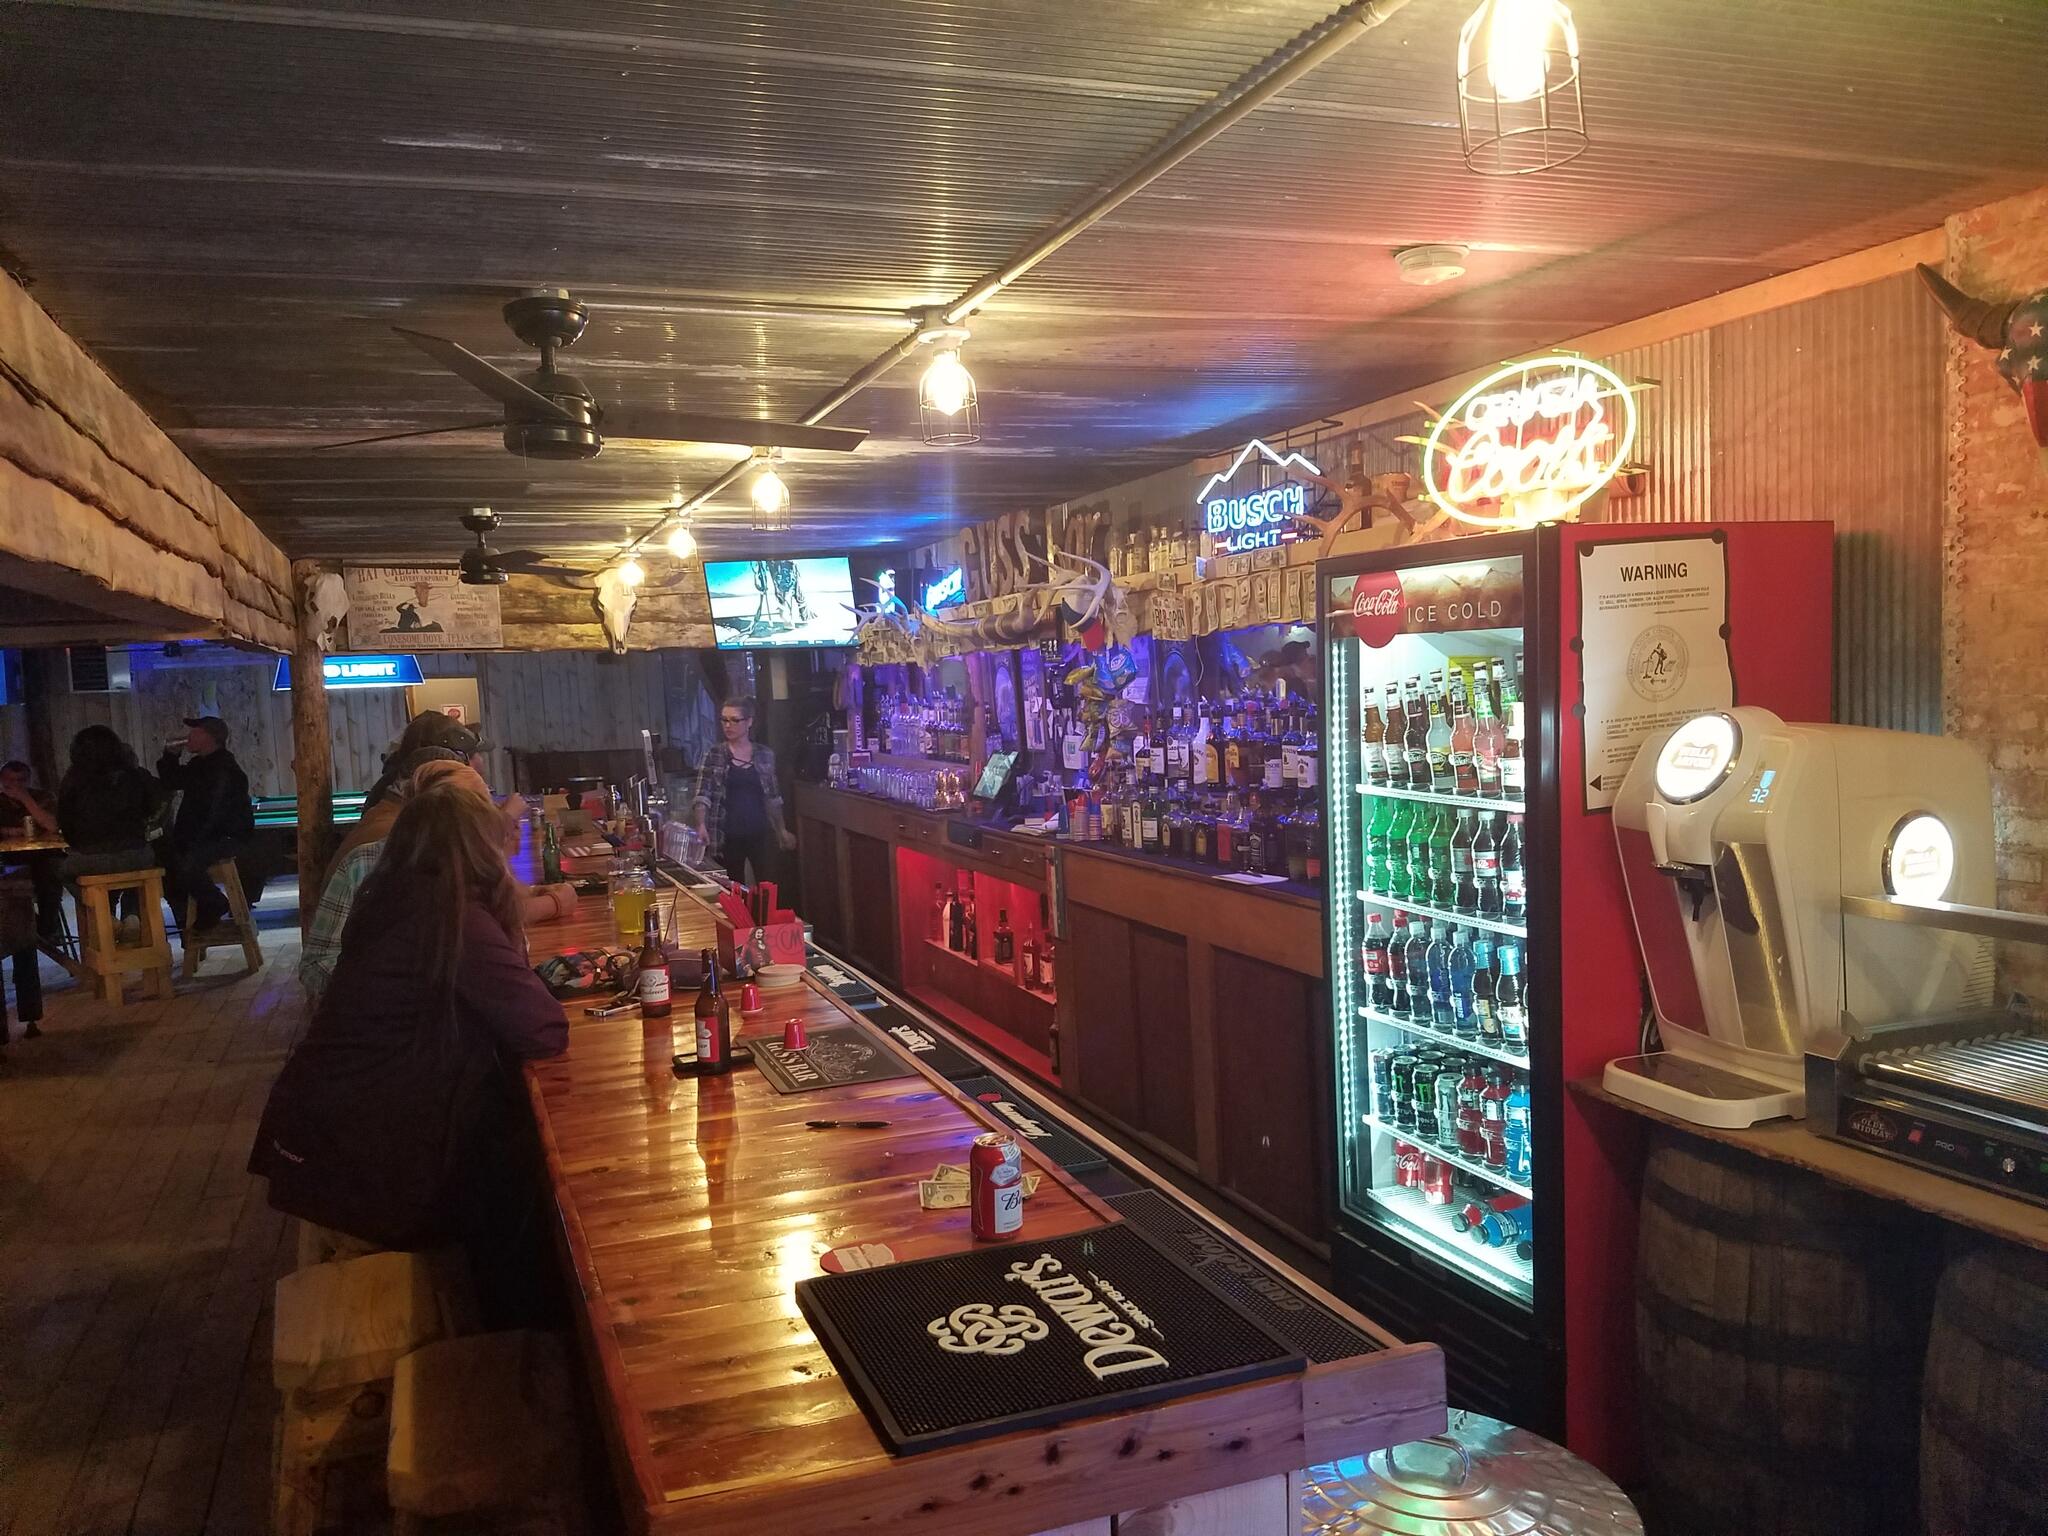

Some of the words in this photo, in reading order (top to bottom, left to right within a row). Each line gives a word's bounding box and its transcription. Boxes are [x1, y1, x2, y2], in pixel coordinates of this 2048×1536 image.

[1206, 486, 1304, 533] BUSCH
[1226, 529, 1281, 551] LIGHT
[1620, 562, 1688, 583] WARNING
[1354, 587, 1401, 617] Coca-Cola
[1407, 605, 1437, 624] ICE
[1447, 600, 1503, 622] COLD
[1749, 788, 1770, 804] 32
[1851, 1122, 1892, 1139] MIDWAY
[1861, 1118, 1886, 1130] OLDE
